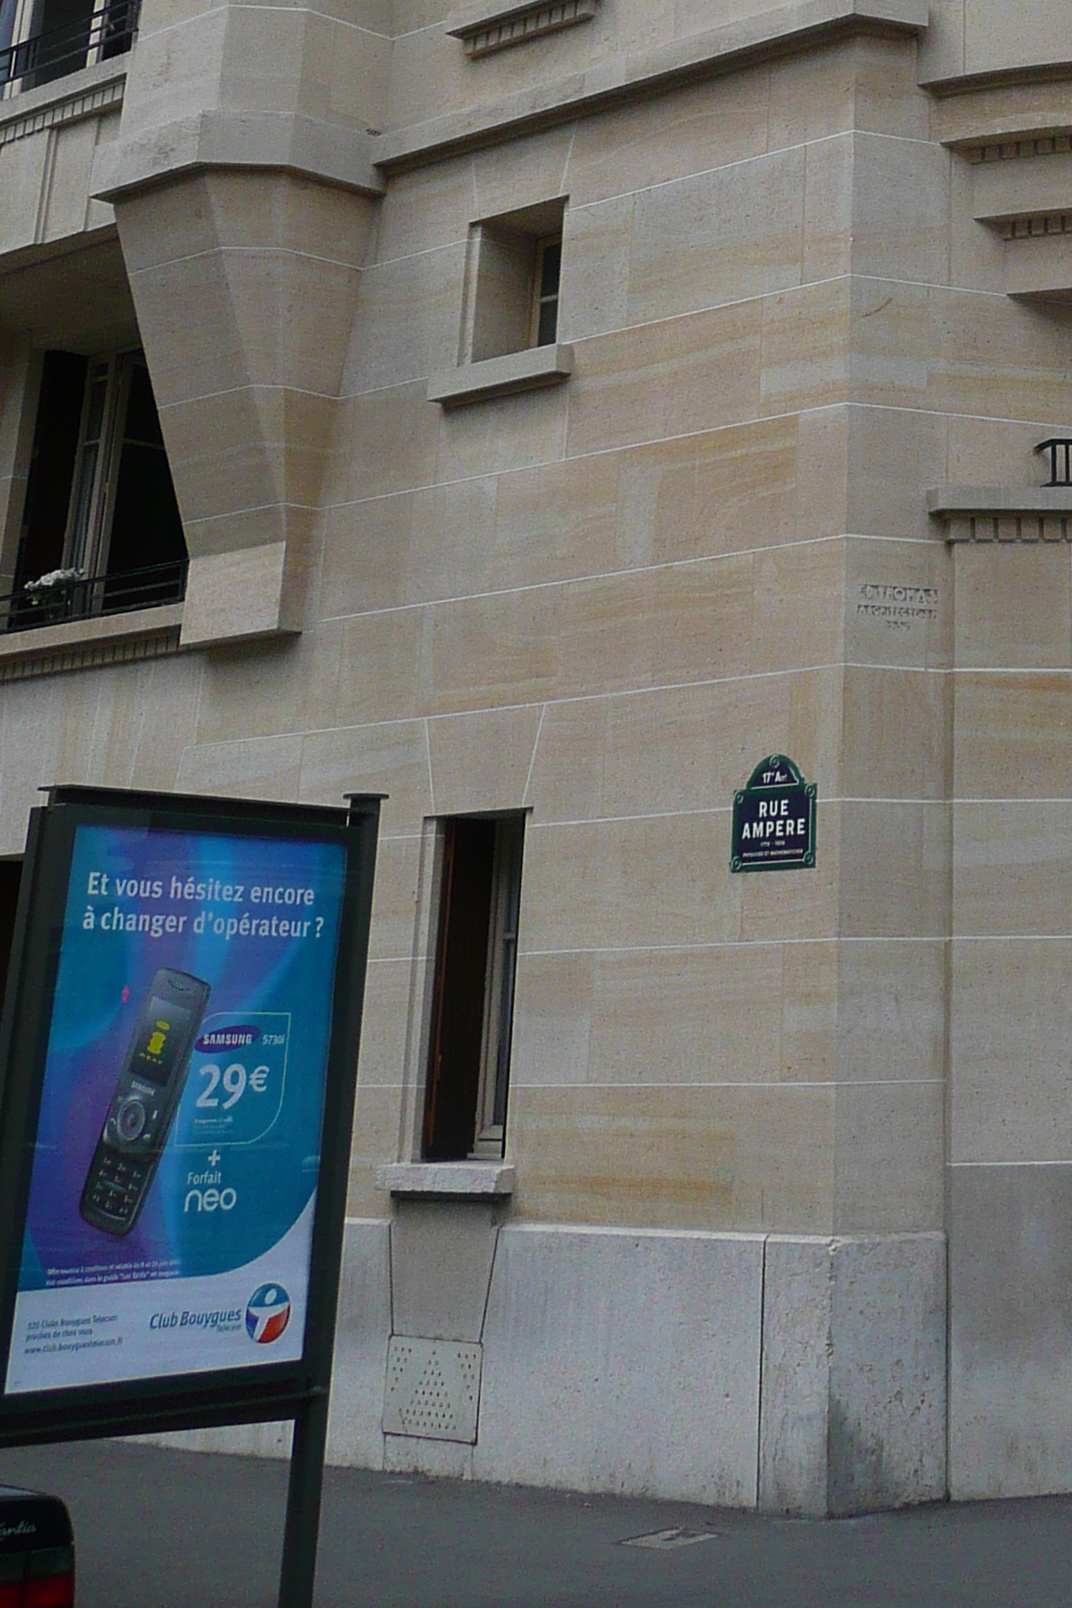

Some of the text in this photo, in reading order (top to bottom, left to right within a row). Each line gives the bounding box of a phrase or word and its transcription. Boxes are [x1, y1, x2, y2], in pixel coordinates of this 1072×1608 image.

[759, 799, 789, 818] RUE
[742, 818, 806, 839] AMPERE
[87, 871, 315, 905] Et vous hésitez encore
[82, 905, 94, 930] à
[101, 907, 187, 938] changer
[203, 1034, 252, 1045] SAMSUNG
[196, 1063, 270, 1110] 29€
[187, 1172, 222, 1185] Forfait
[184, 1187, 237, 1213] neo
[150, 1309, 242, 1329] Club Bouygues
